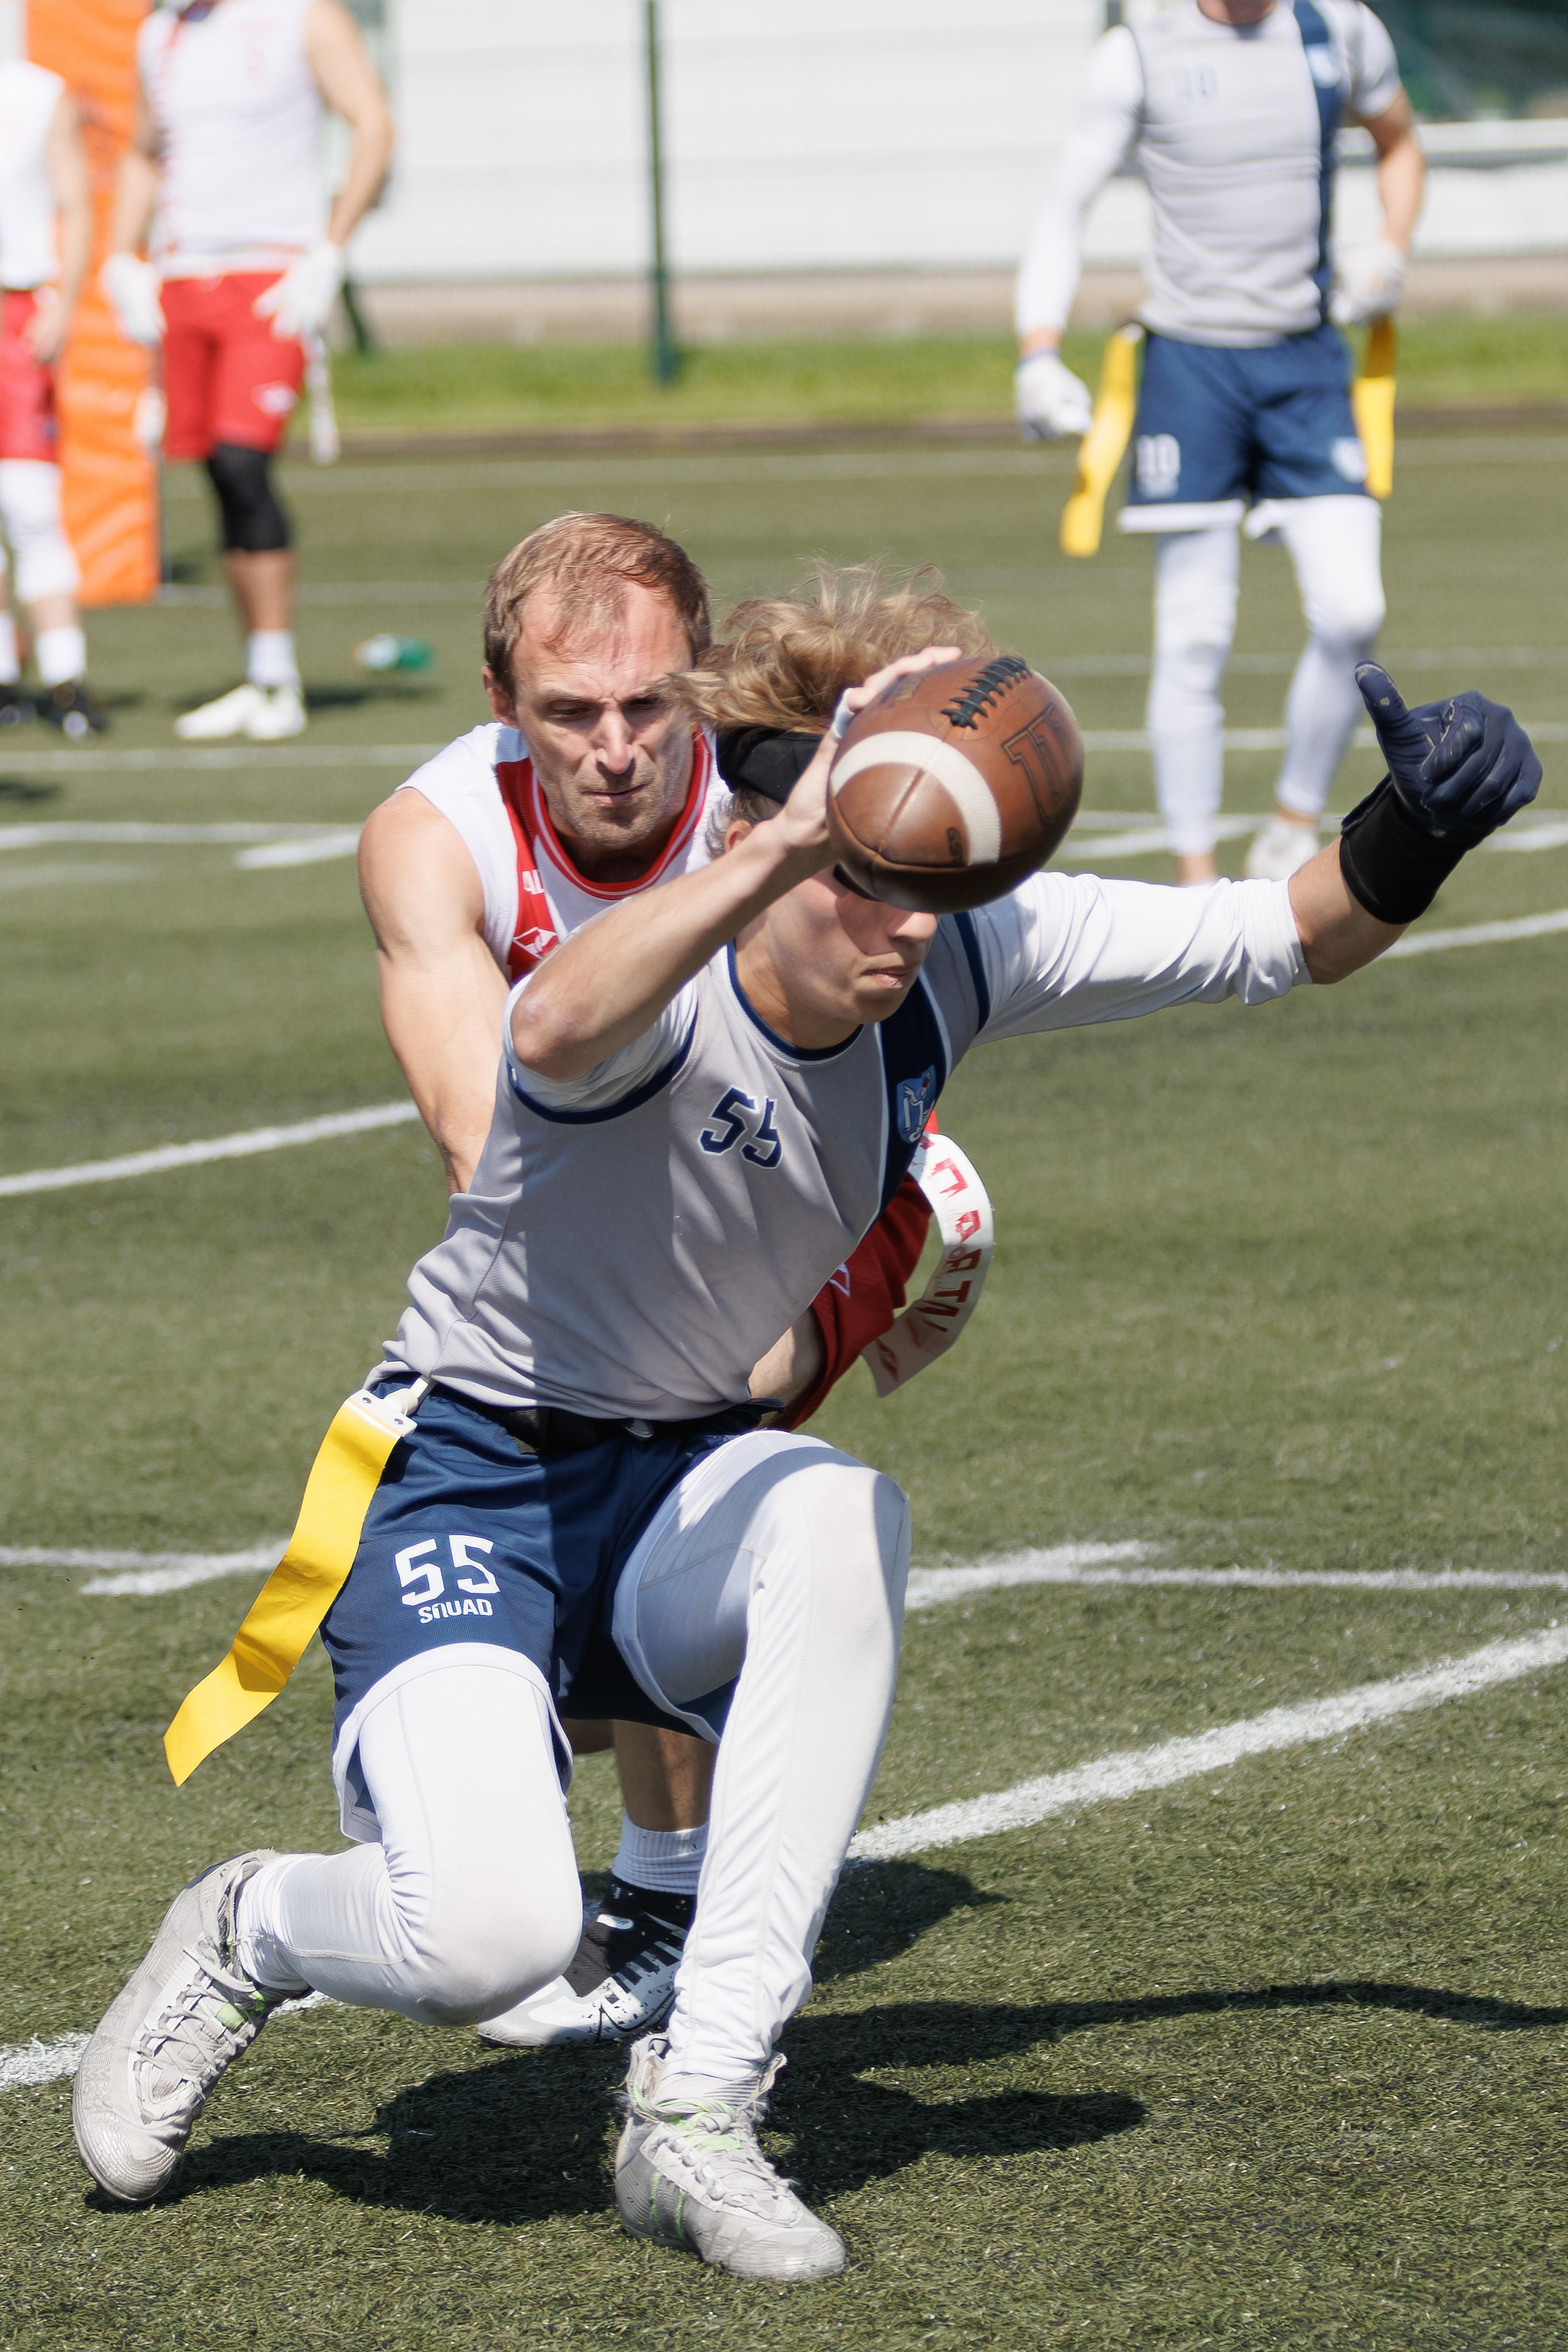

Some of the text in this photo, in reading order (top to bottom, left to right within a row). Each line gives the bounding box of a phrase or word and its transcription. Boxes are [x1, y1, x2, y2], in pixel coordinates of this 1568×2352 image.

[1137, 434, 1180, 480] 10
[698, 1084, 783, 1169] 55
[394, 1534, 501, 1606] 55
